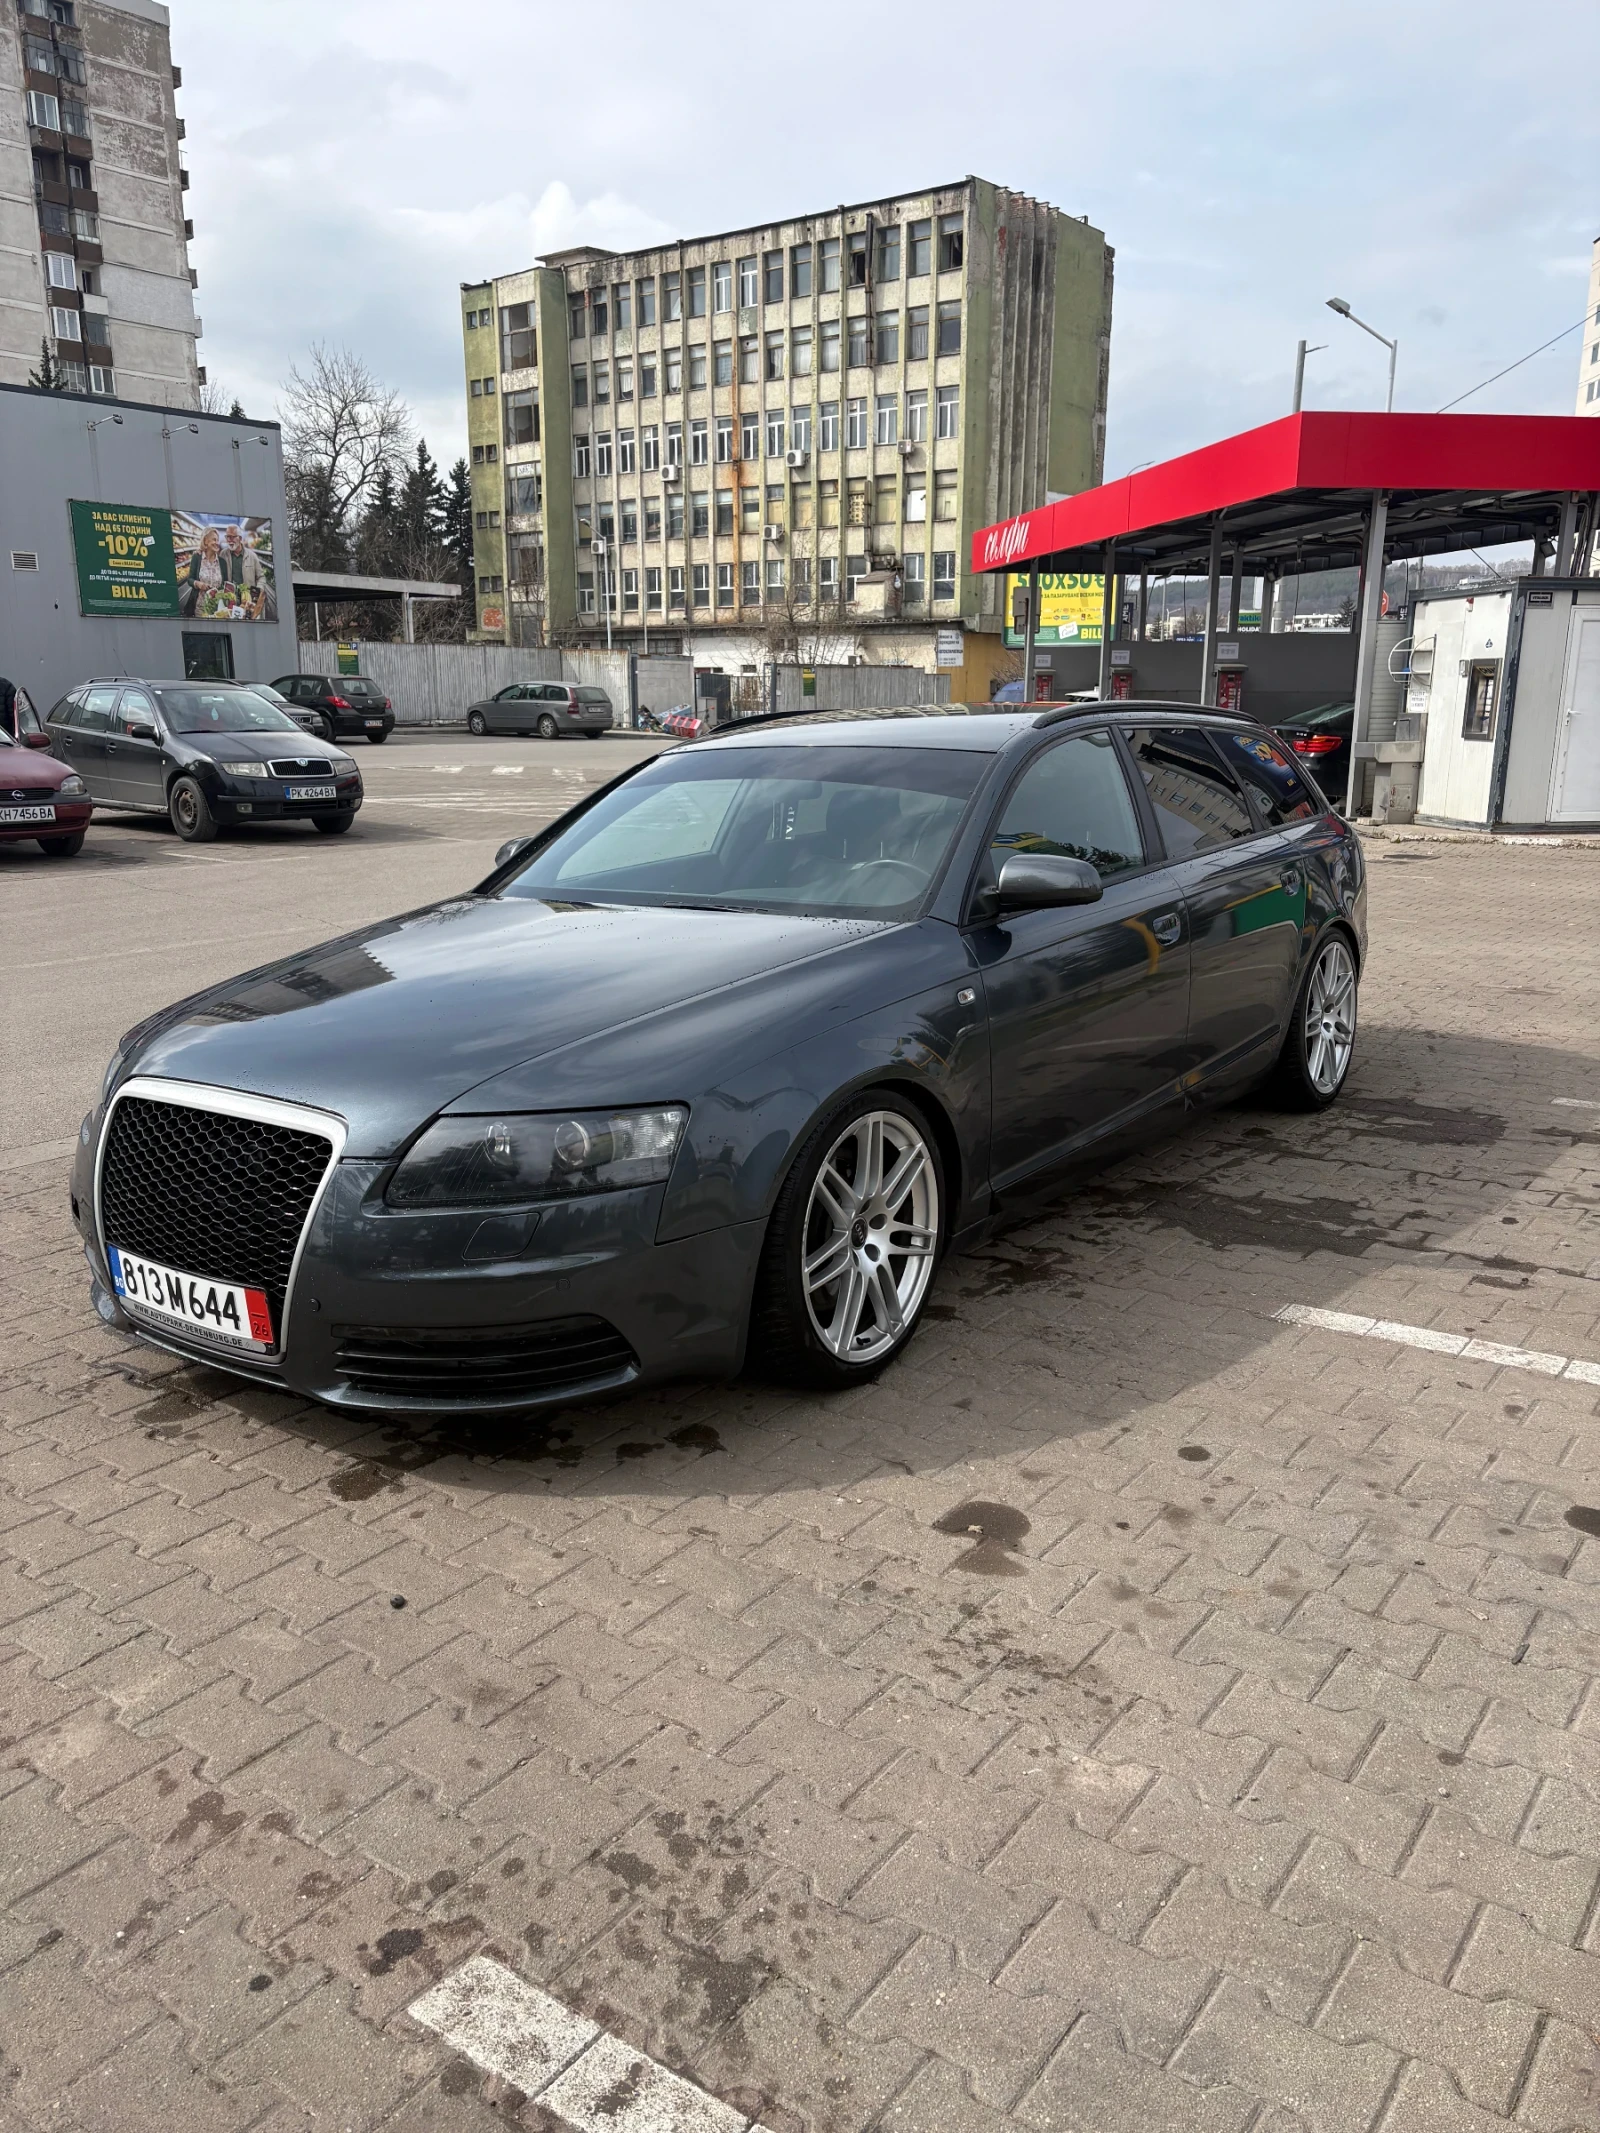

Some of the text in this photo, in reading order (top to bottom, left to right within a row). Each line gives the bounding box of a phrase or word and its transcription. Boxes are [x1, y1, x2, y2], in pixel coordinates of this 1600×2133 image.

[92, 511, 151, 524] ЗА ВАС КЛИЕНТИ
[95, 522, 151, 535] НАД 65 ГОДИНИ
[98, 534, 148, 557] -10%
[112, 585, 147, 599] BILLA
[1081, 628, 1102, 640] BILL
[291, 787, 335, 798] PK 4264 BX
[12, 808, 38, 820] 7456
[40, 807, 53, 819] BA
[122, 1257, 241, 1331] 813M644
[133, 1303, 243, 1347] WWW.AUTOPARK-DERENBURG.DE
[253, 1321, 269, 1336] 26
